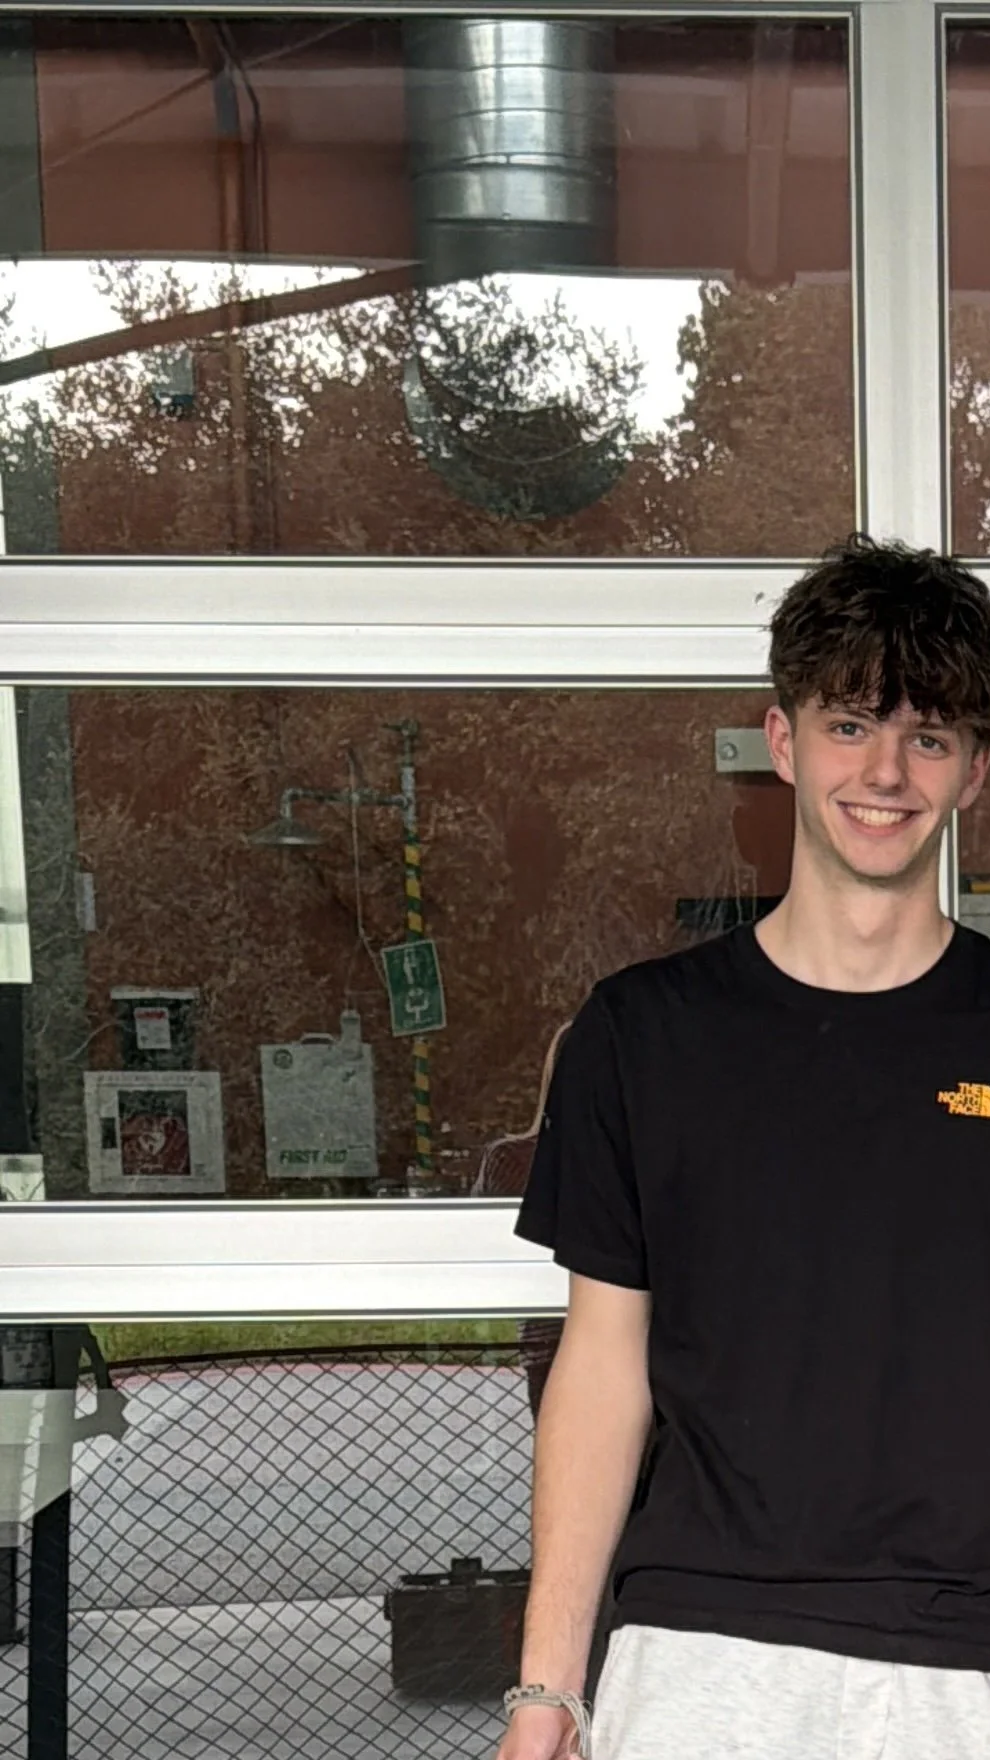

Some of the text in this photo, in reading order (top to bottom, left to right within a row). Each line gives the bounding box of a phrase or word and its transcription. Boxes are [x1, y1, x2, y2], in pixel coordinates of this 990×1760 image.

[958, 1082, 982, 1095] THE
[938, 1091, 981, 1105] NORTH
[949, 1103, 982, 1116] FACE
[279, 1149, 320, 1165] FIRST
